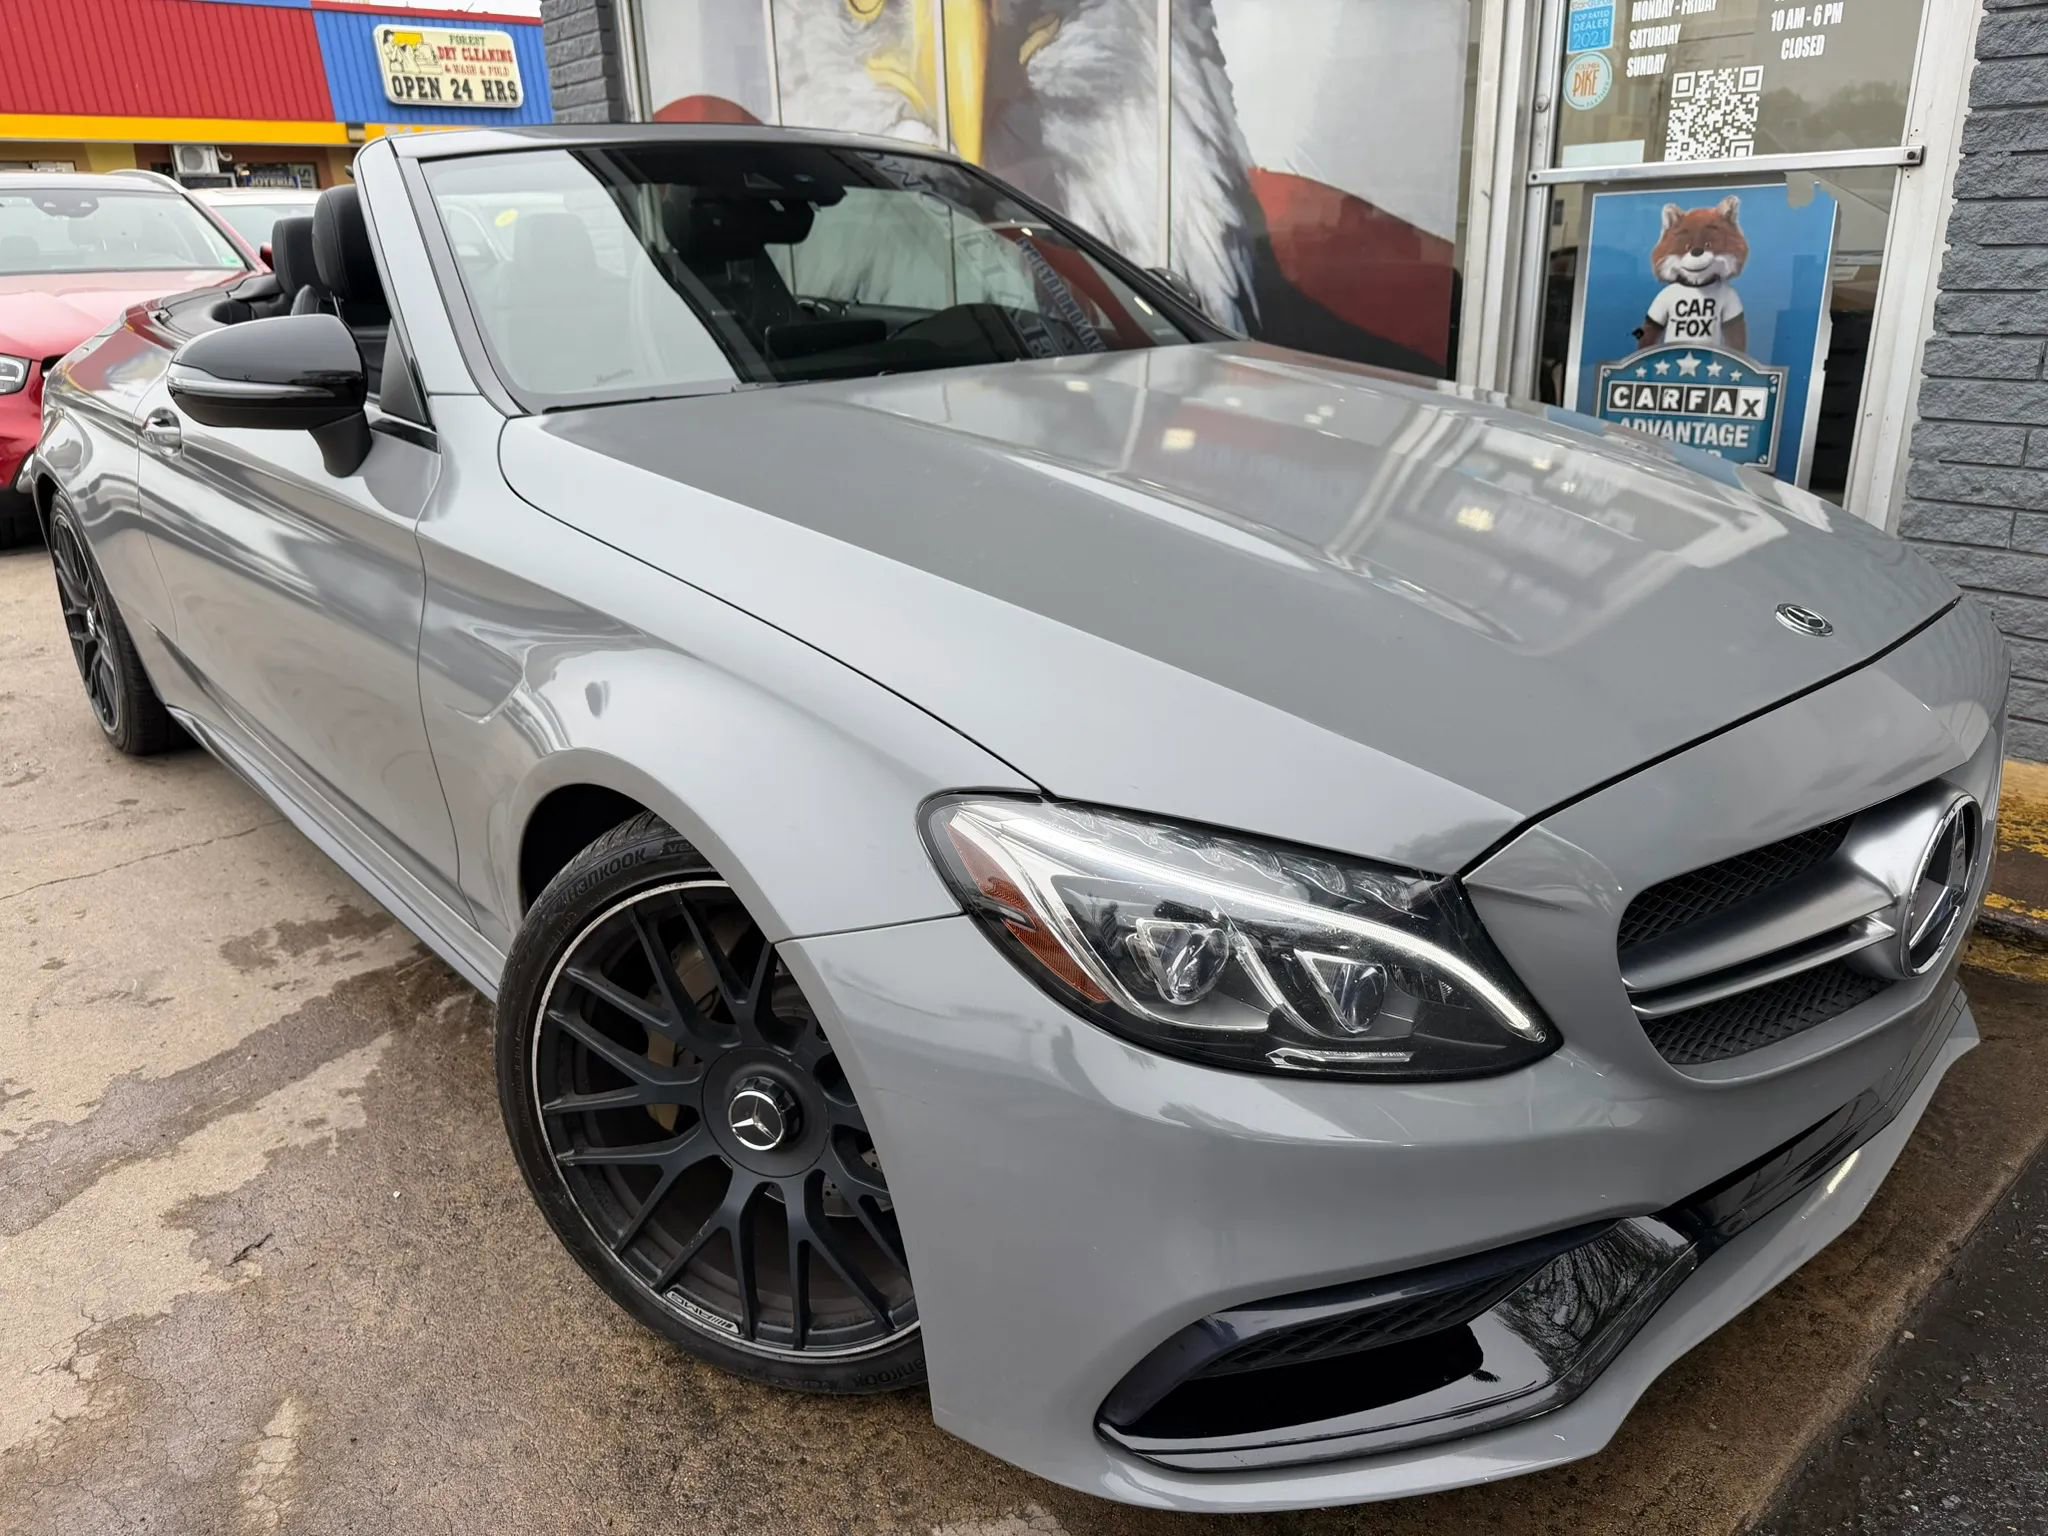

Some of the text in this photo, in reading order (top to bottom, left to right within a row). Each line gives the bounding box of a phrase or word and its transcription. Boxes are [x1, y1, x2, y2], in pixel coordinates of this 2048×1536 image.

[1574, 10, 1610, 21] TOP RATED
[1632, 0, 1675, 22] MONDAY
[1681, 0, 1718, 15] FRIDAY
[1771, 10, 1785, 31] 10
[1785, 7, 1806, 30] AM
[1813, 4, 1823, 27] 6
[1823, 2, 1844, 25] PM
[1573, 19, 1609, 32] DEALER
[449, 34, 485, 46] FOREST
[1573, 30, 1608, 49] 2021
[1629, 24, 1681, 50] SATURDAY
[1781, 34, 1826, 60] CLOSED
[437, 46, 513, 63] DRY CLEANING
[1626, 53, 1667, 78] SUNDAY
[391, 75, 518, 102] OPEN 24 HRS
[1572, 70, 1600, 97] PIKE
[1675, 298, 1716, 317] CAR
[1675, 319, 1712, 337] FOX
[1613, 386, 1761, 417] CARFAX
